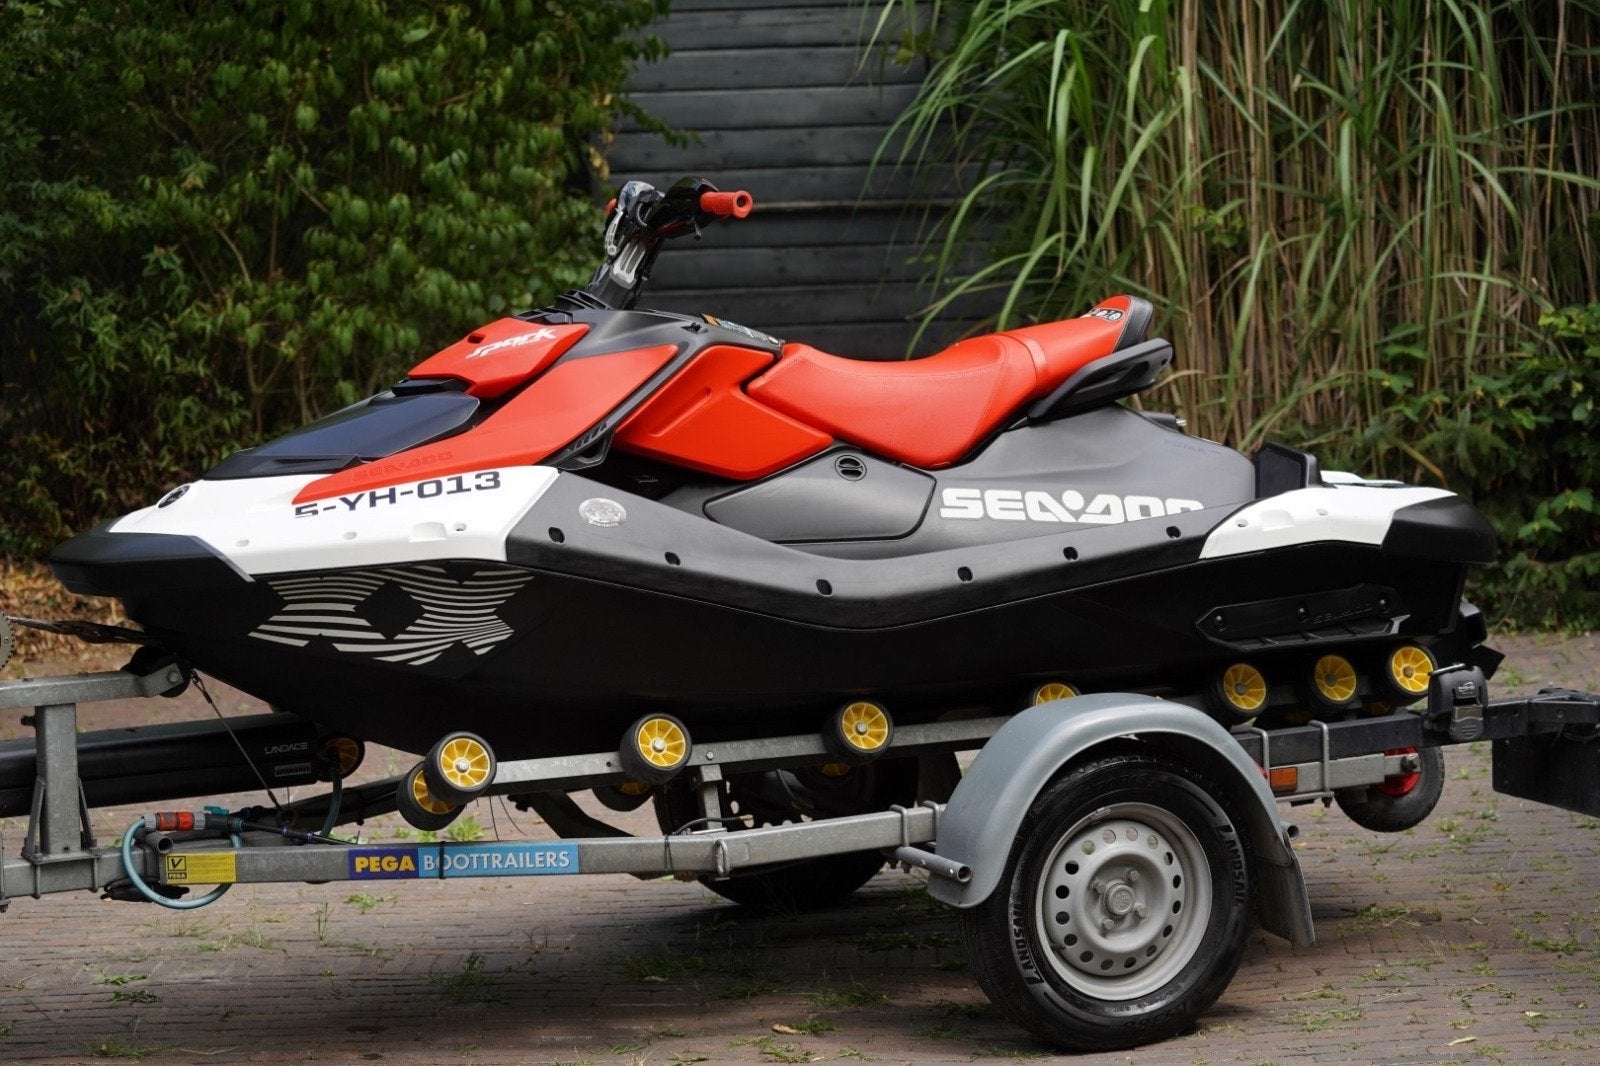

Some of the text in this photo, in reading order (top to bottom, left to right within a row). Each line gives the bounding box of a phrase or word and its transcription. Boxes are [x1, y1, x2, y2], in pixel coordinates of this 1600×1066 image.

[294, 470, 501, 518] 5-YH-013
[354, 851, 570, 873] PEGA BOOTTRAILERS
